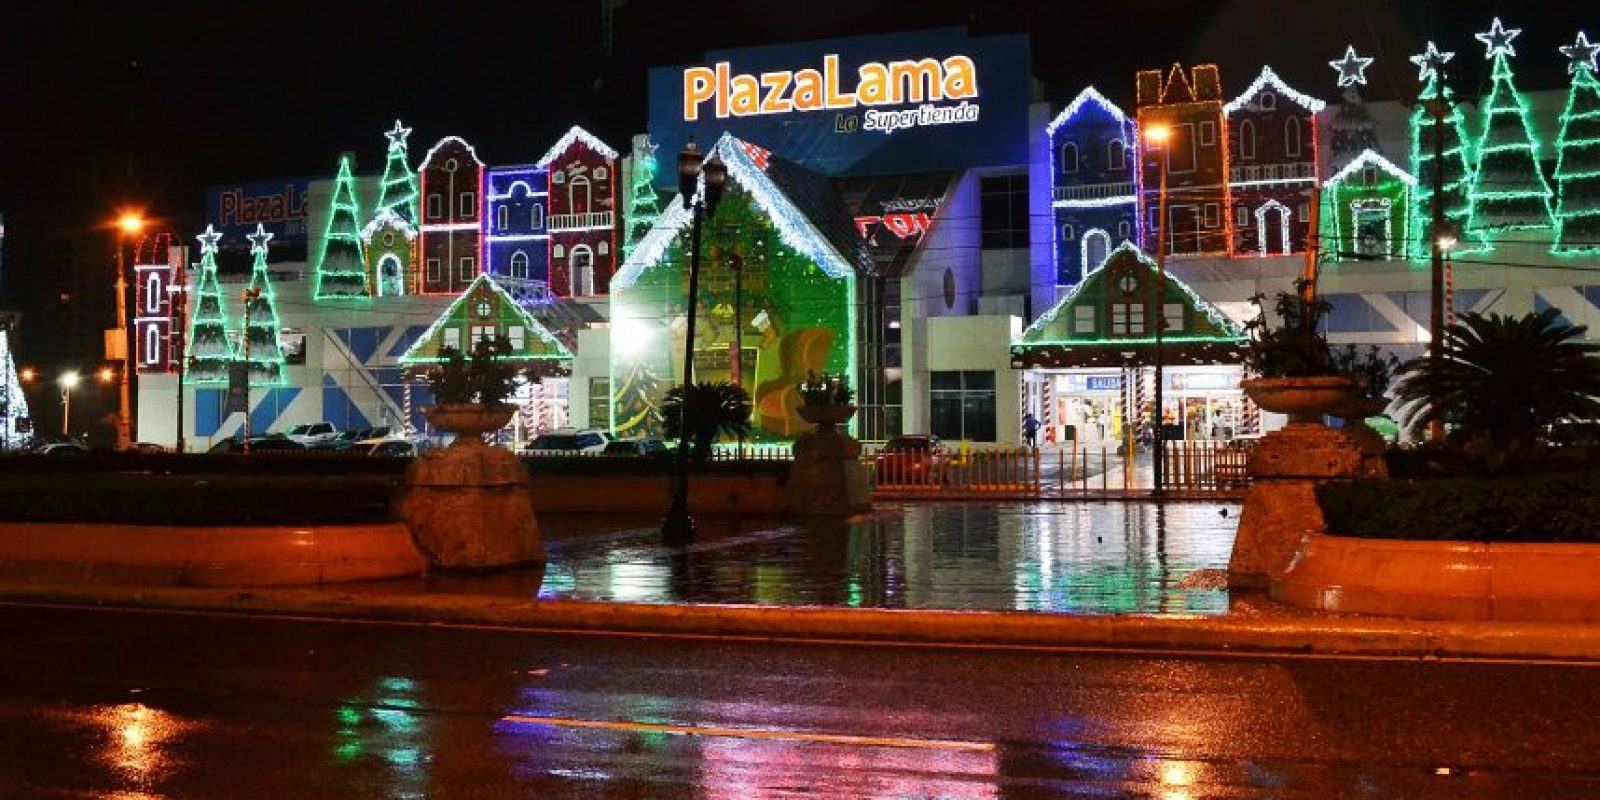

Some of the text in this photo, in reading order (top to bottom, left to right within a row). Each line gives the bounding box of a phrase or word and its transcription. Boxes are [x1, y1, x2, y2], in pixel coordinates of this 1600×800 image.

[684, 54, 979, 121] PlazaLama
[835, 101, 980, 134] La Supertienda
